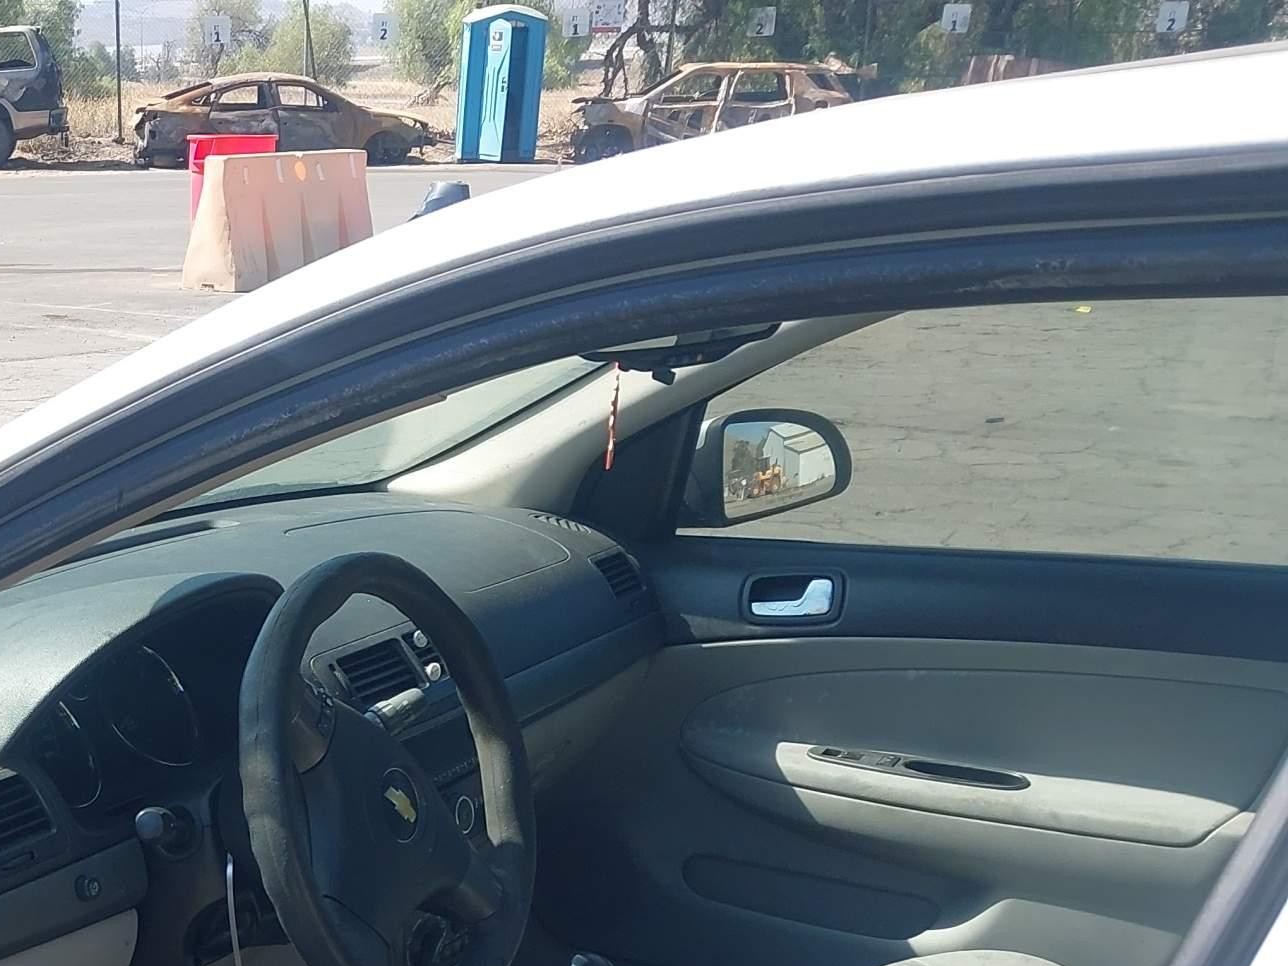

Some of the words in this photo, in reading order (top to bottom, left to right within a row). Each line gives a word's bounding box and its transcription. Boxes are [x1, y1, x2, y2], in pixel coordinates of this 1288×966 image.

[572, 24, 579, 35] 1
[756, 24, 764, 35] 2
[950, 20, 957, 31] 1
[1166, 18, 1175, 31] 2
[214, 31, 222, 42] 1
[380, 28, 388, 40] 2
